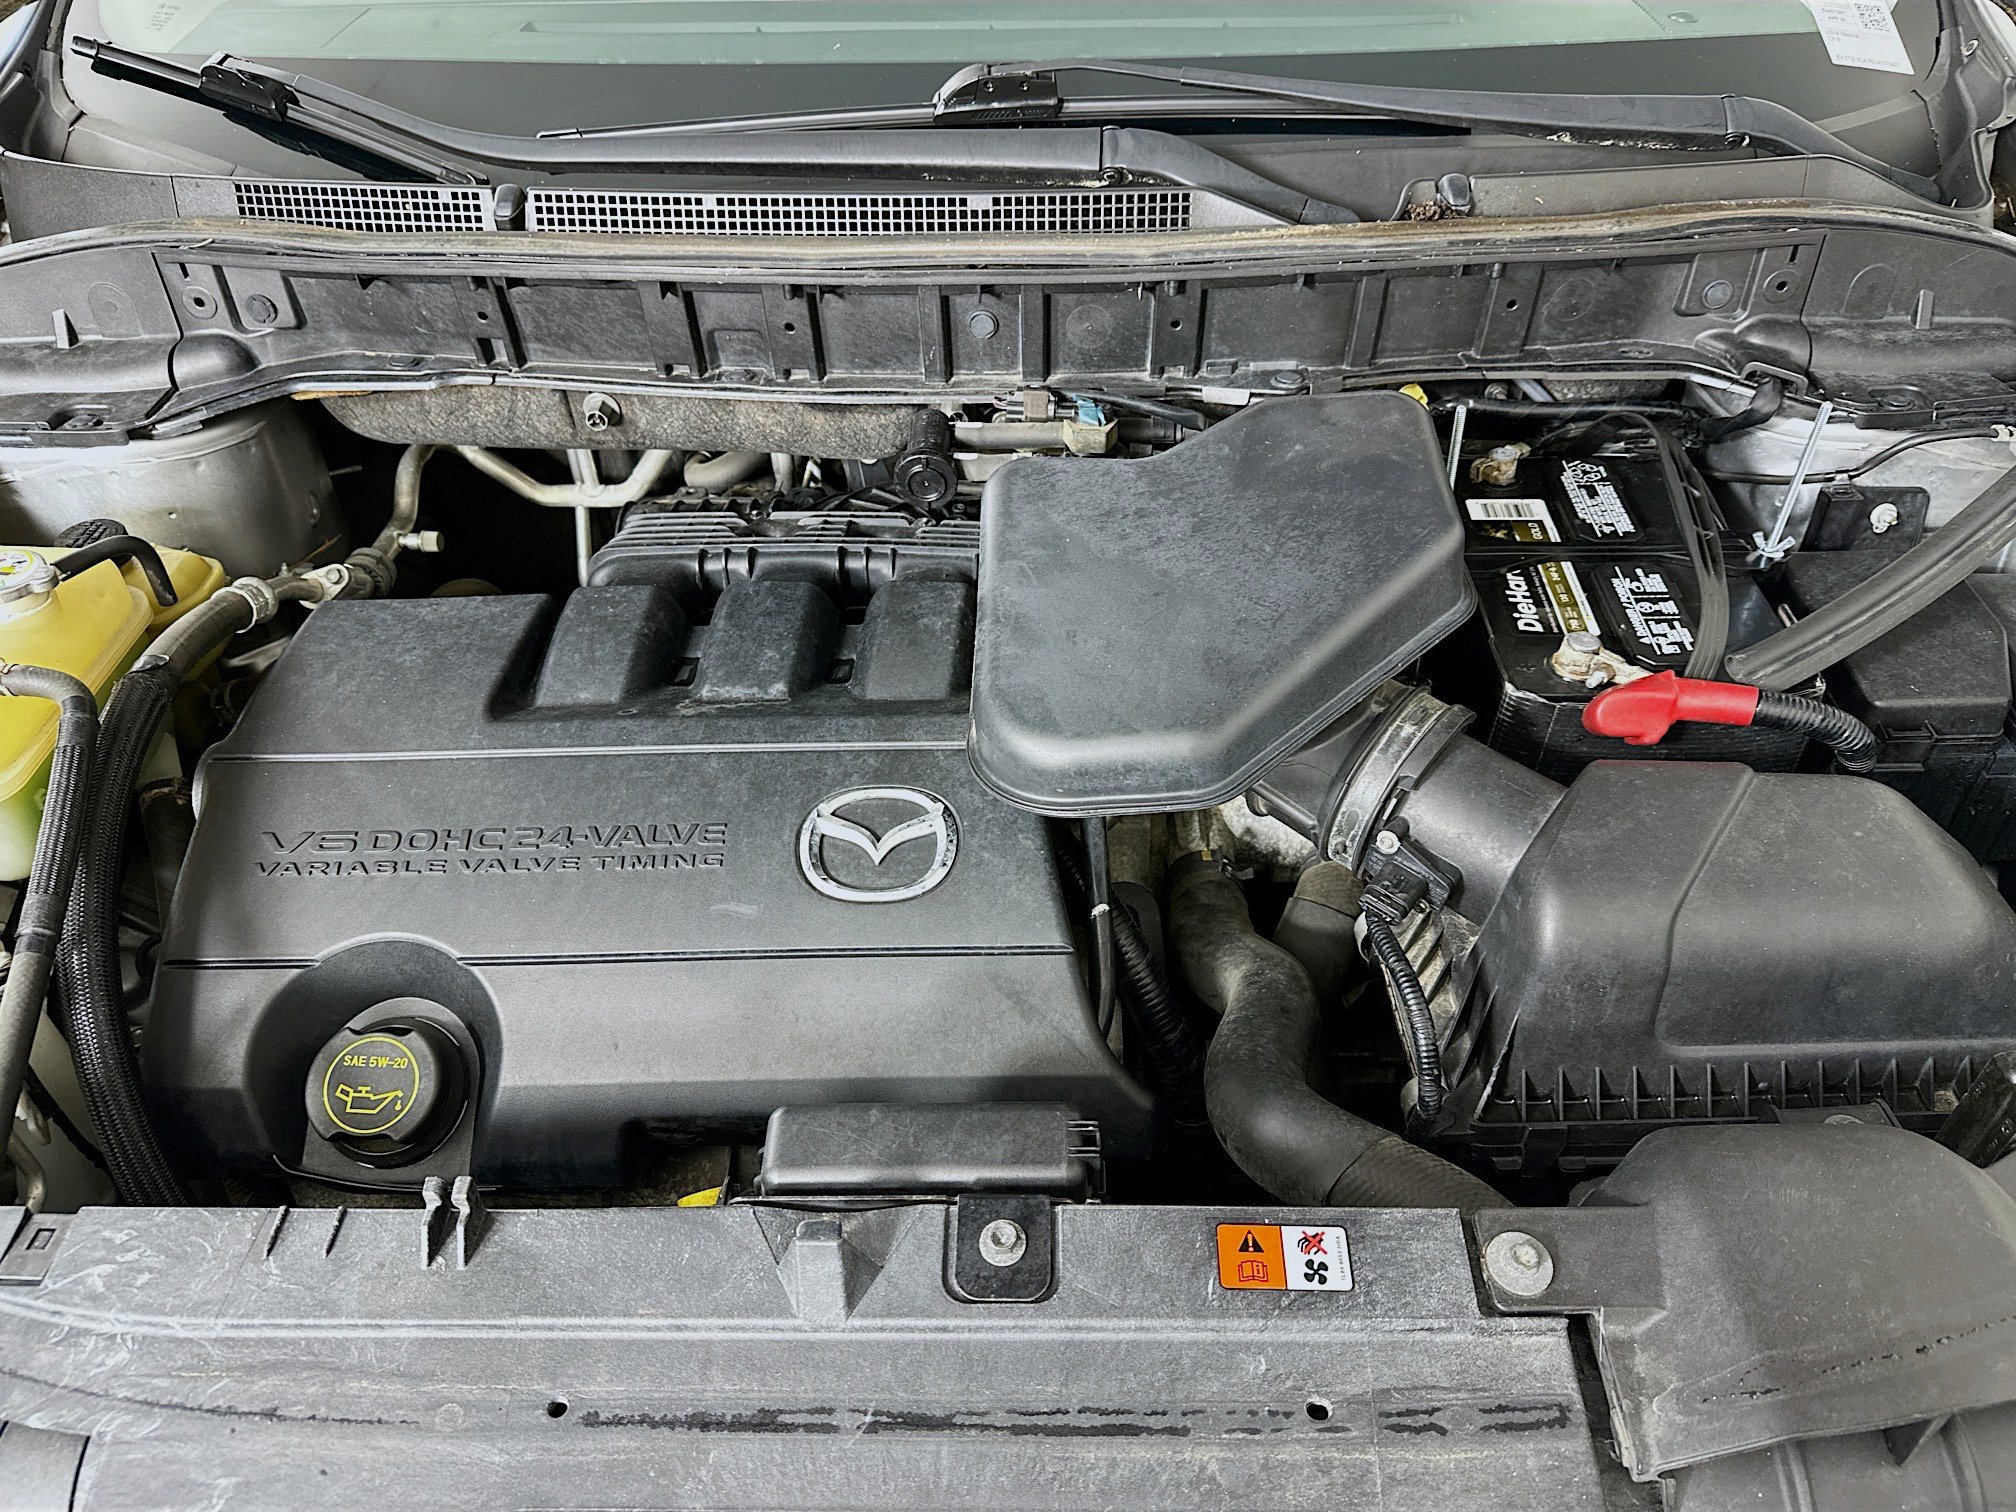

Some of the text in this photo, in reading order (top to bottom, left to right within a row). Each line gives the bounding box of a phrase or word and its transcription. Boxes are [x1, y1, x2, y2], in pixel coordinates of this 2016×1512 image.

[1527, 522, 1543, 540] GOLD
[260, 822, 728, 854] V6 DOHC 24-VALVE
[253, 852, 725, 877] VARIABLE VALVE TIMING
[343, 1055, 408, 1069] SAE 5W-20
